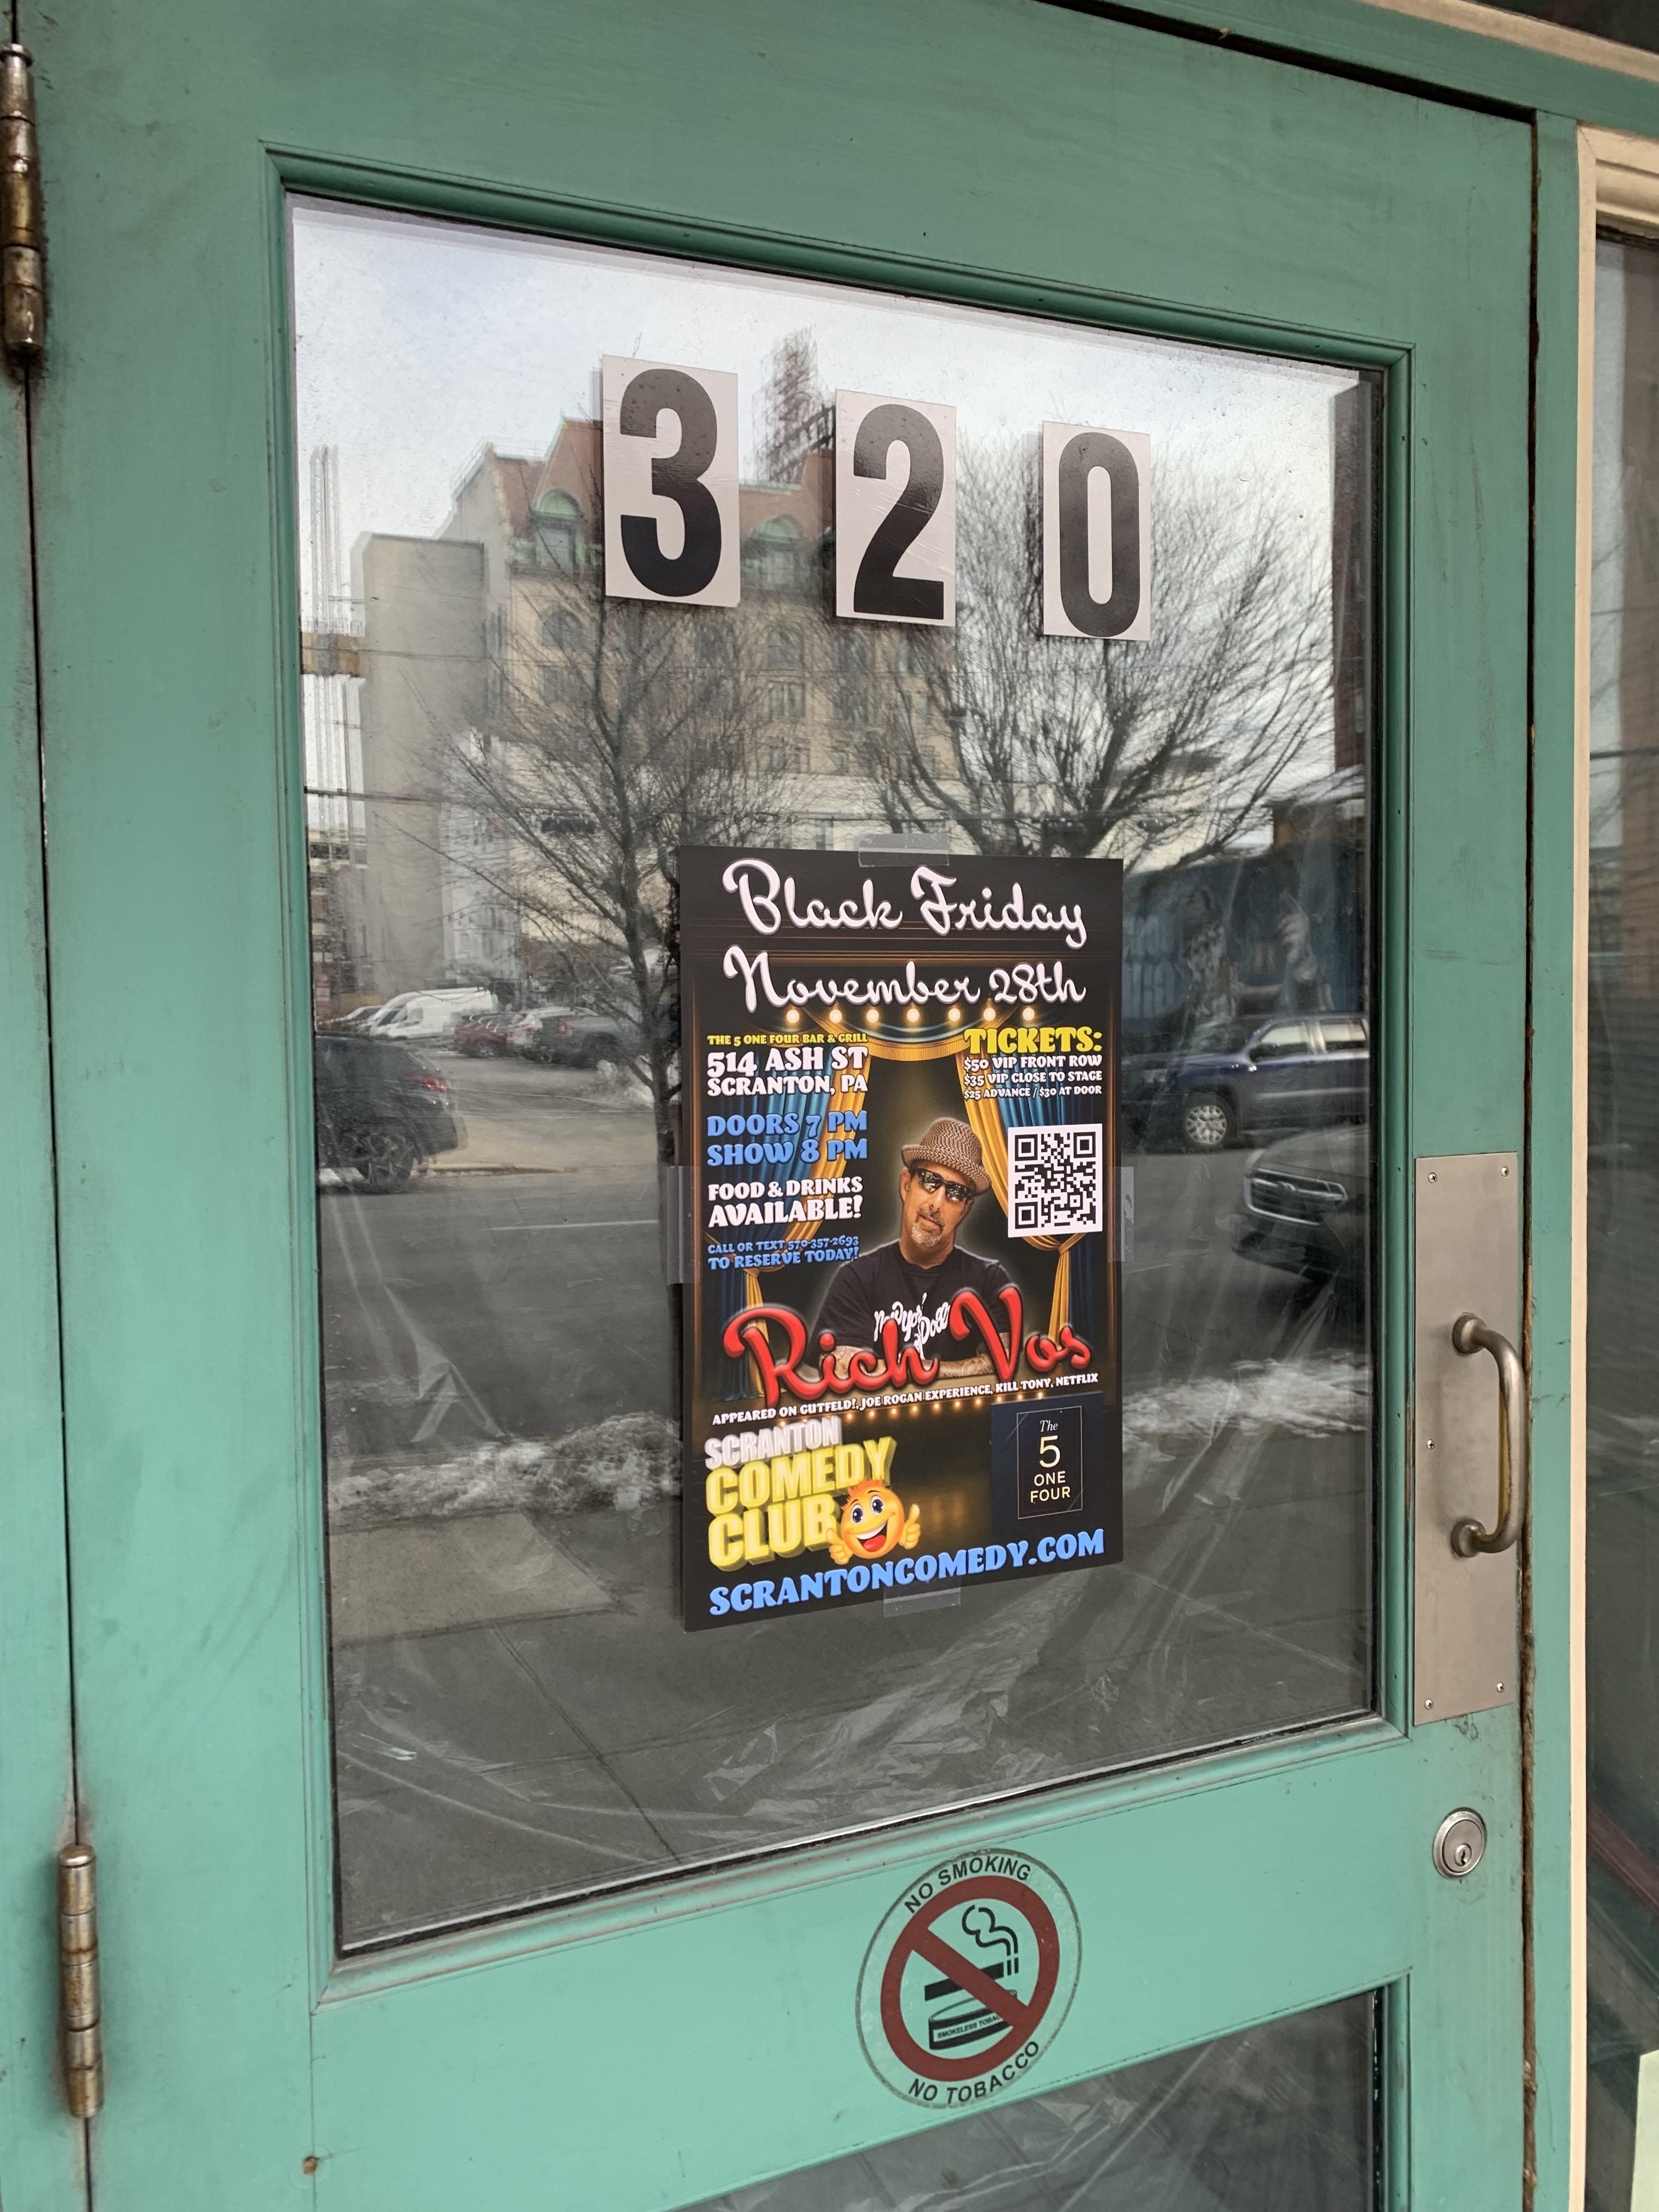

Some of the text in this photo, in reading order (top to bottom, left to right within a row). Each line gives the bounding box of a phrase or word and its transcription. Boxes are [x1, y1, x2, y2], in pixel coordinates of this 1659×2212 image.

[620, 369, 1139, 637] 320
[723, 858, 902, 935] Black
[911, 866, 1086, 948] Friday
[723, 945, 981, 1013] November
[989, 961, 1086, 1005] 28th
[707, 1033, 868, 1046] THE 5 ONE FOUR BAR & GRILL
[964, 1026, 1102, 1053] TICKETS:
[707, 1046, 868, 1077] 514 ASH ST
[964, 1055, 1102, 1072] $50 VIP FRONT ROW
[707, 1074, 868, 1096] SCRANTON, PA
[964, 1070, 1102, 1087] $35 VIP CLOSE TO STAGE
[964, 1086, 1102, 1101] $25 ADVANCE / $30 AT DOOR
[707, 1111, 867, 1137] DOORS 7 PM
[707, 1138, 867, 1166] SHOW 8 PM
[708, 1177, 863, 1200] FOOD & DRINKS
[708, 1195, 863, 1227] AVAILABLE!
[708, 1235, 859, 1254] CALL OR TEXT 570-357-2693
[708, 1246, 859, 1269] TO RESERVE TODAY!
[723, 1285, 1092, 1408] Rich Vos
[712, 1373, 1098, 1425] APPEARED ON GUTFELD!, JOE ROGAN EXPERIENCE, KILL TONY, NETFLIX
[1040, 1420, 1058, 1432] The
[704, 1415, 842, 1470] SCRANTON
[1040, 1435, 1060, 1468] 5
[706, 1436, 897, 1516] COMEDY
[1034, 1471, 1065, 1486] ONE
[1030, 1486, 1070, 1503] FOUR
[708, 1494, 841, 1572] CLUB
[709, 1528, 1105, 1616] SCRANTONCOMEDY.COM
[904, 1856, 1031, 1913] NO SMOKING
[938, 2023, 977, 2038] SMOKELESS
[909, 2041, 1039, 2104] NO TOBACCO
